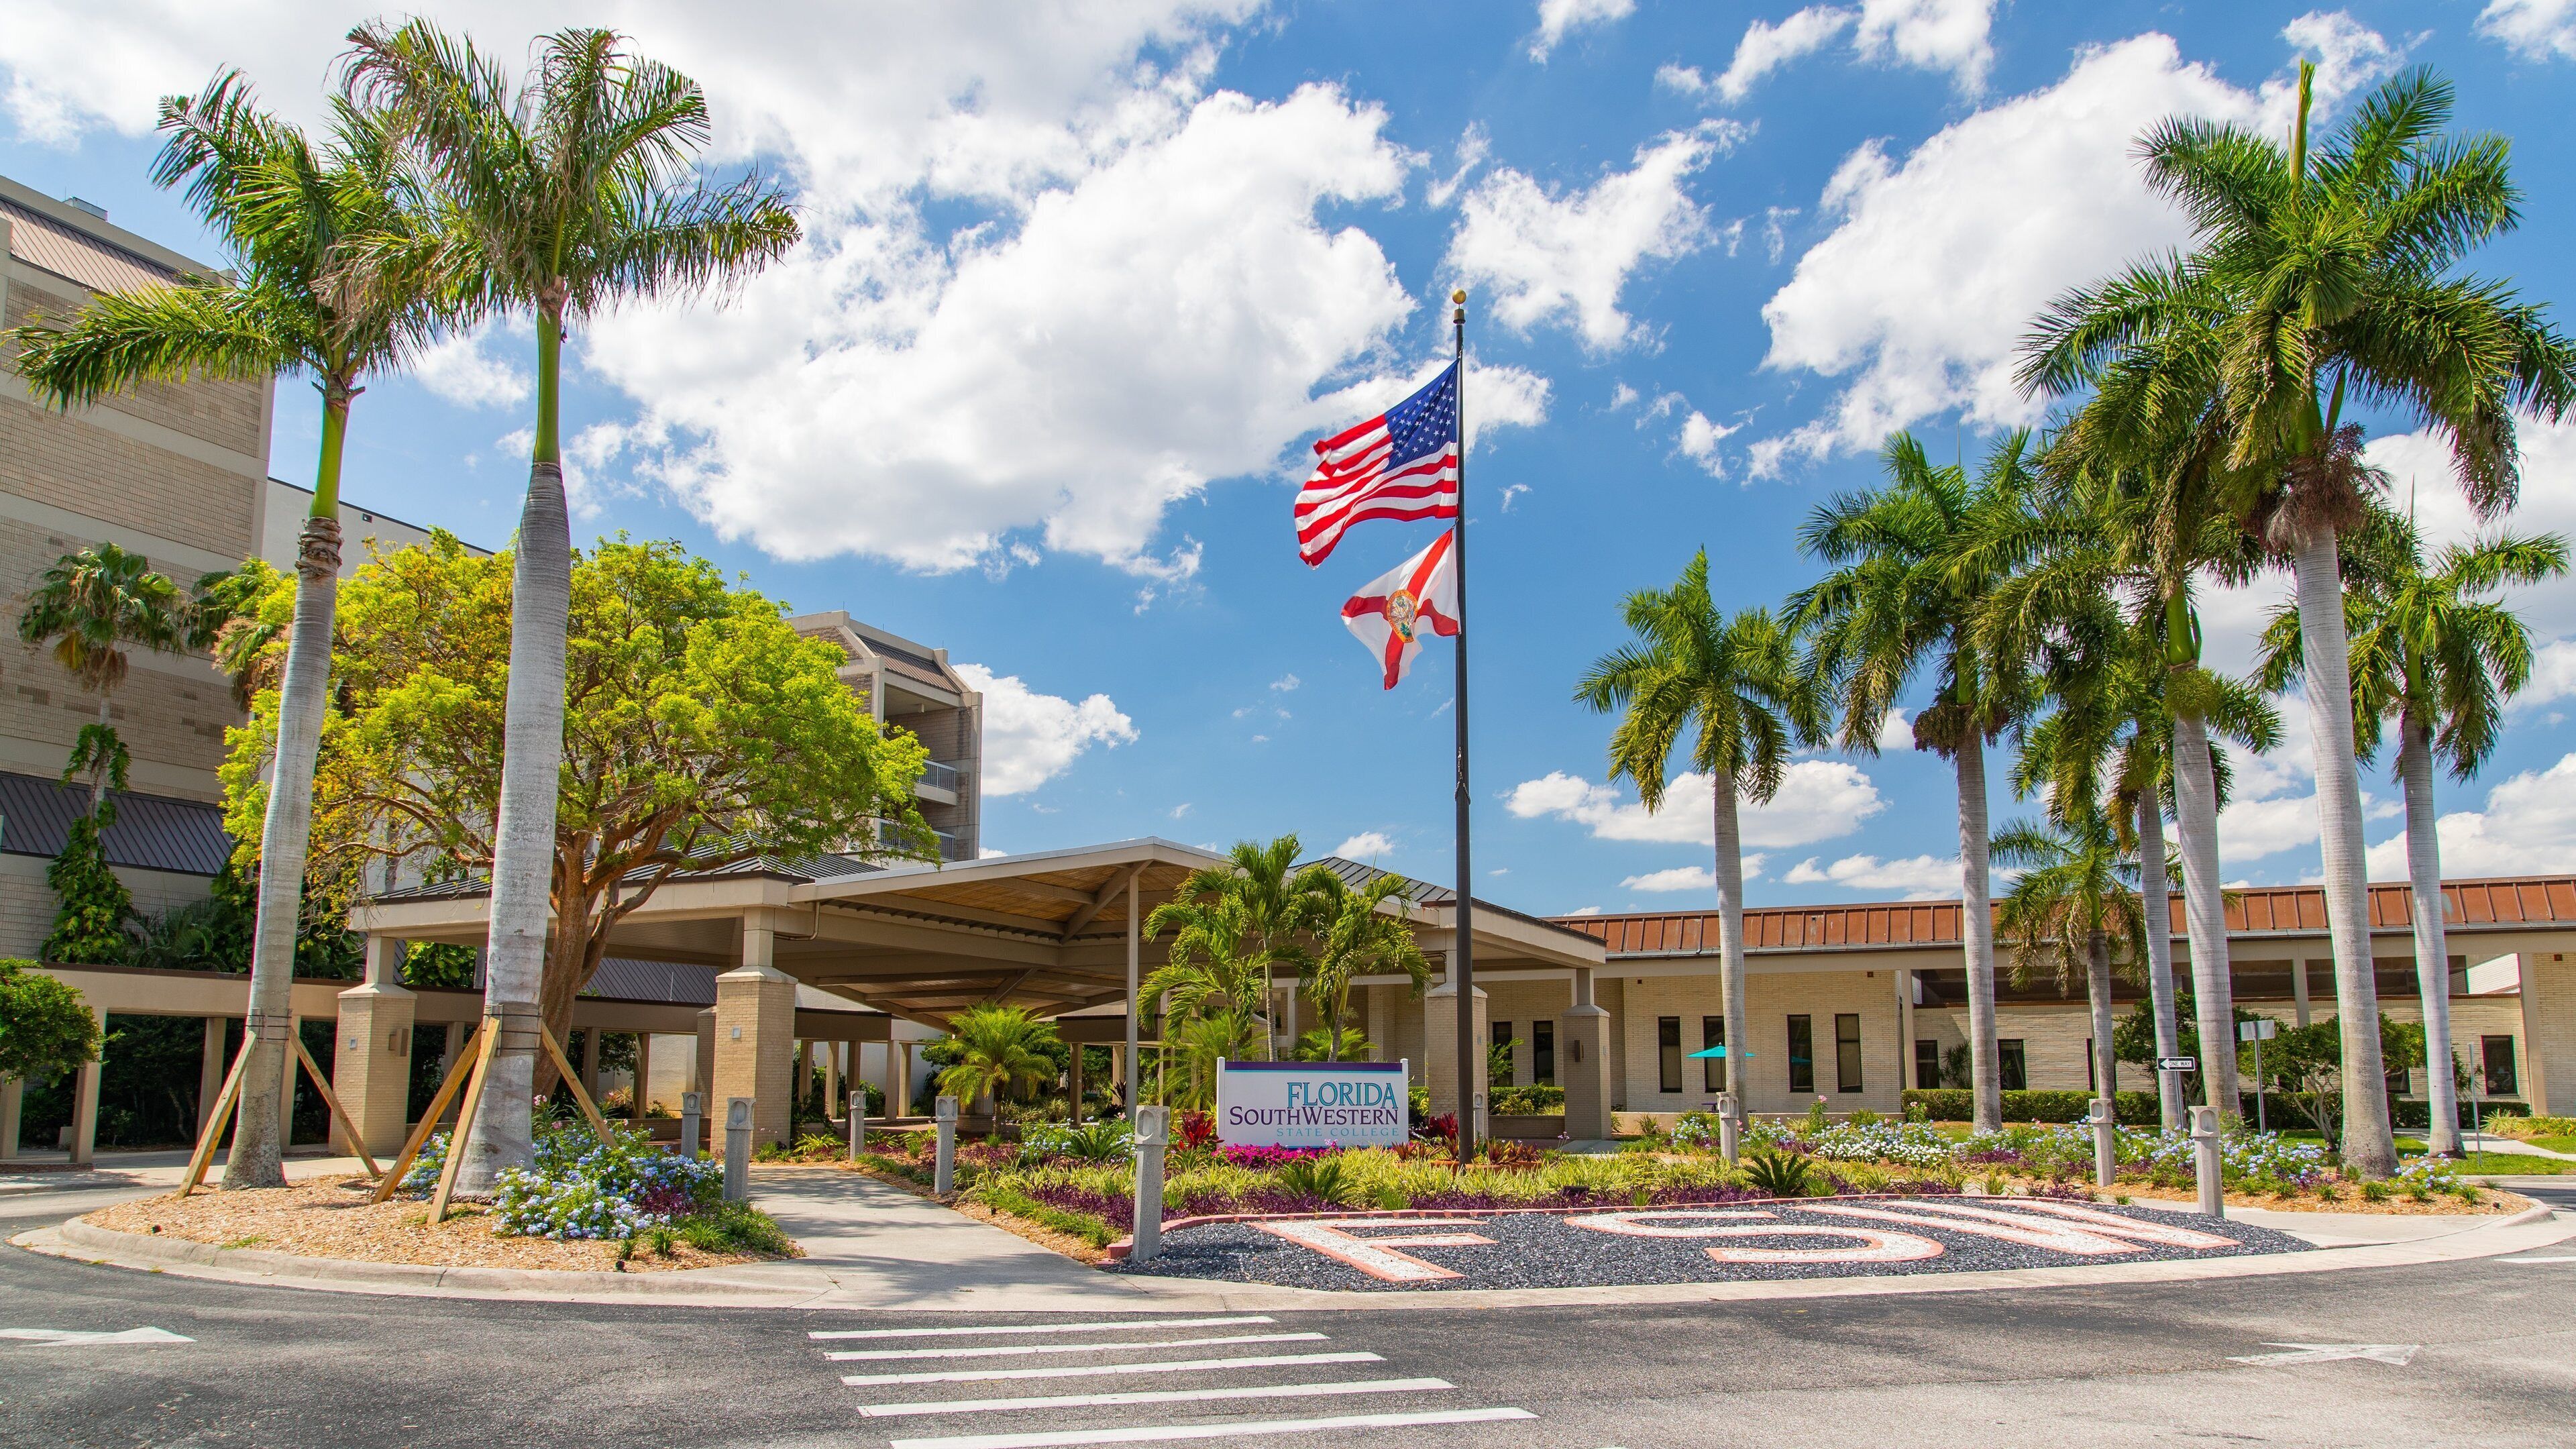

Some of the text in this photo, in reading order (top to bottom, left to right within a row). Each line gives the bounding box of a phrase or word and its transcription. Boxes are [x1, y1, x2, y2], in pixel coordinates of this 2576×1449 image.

[1287, 1081, 1399, 1109] FLORIDA
[1277, 1127, 1399, 1137] STATE COLLEGE
[1248, 1199, 2243, 1282] FSW
